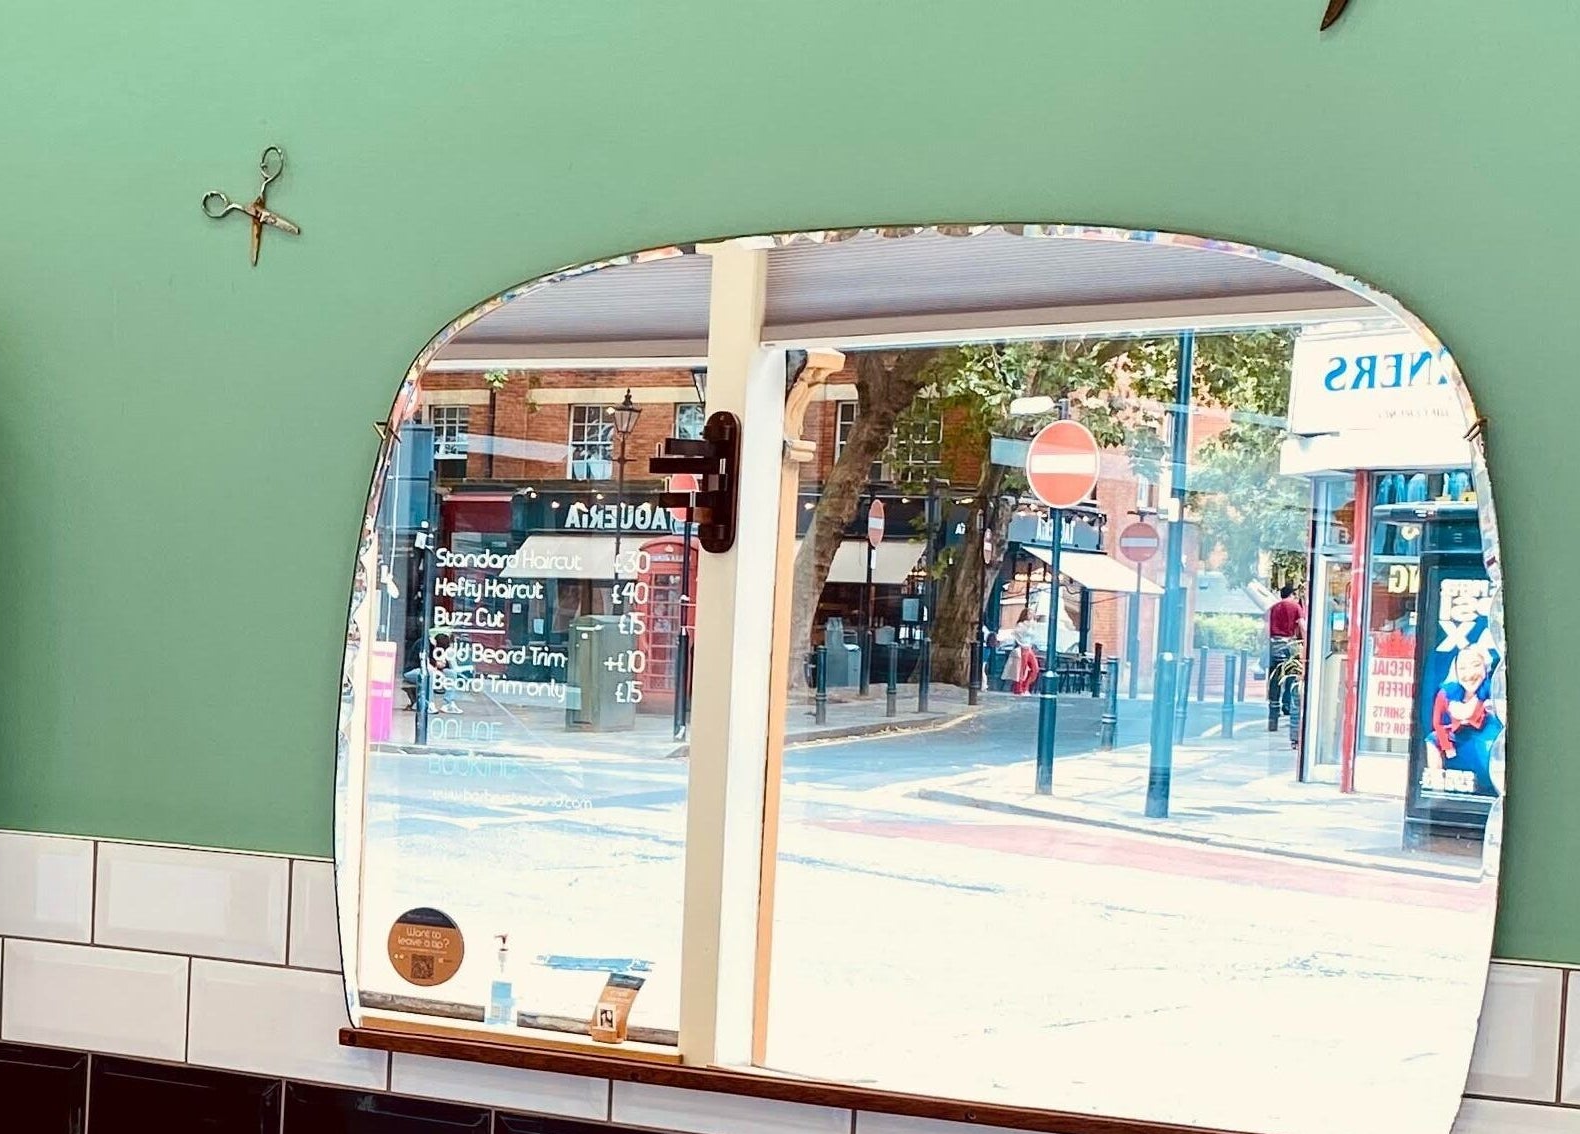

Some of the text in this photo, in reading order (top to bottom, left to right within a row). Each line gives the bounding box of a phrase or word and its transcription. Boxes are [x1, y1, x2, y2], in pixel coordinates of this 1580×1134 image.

[435, 548, 519, 569] Standard
[522, 550, 582, 572] Haircut
[614, 550, 651, 574] £30
[434, 577, 649, 605] Hefty Haircut £40
[434, 607, 646, 635] Buzz Cut £15
[432, 643, 646, 674] add Beard Trim +£10
[432, 673, 642, 704] Beard Trim only £15
[397, 936, 423, 946] leave
[423, 940, 431, 948] a
[406, 927, 442, 940] Want to
